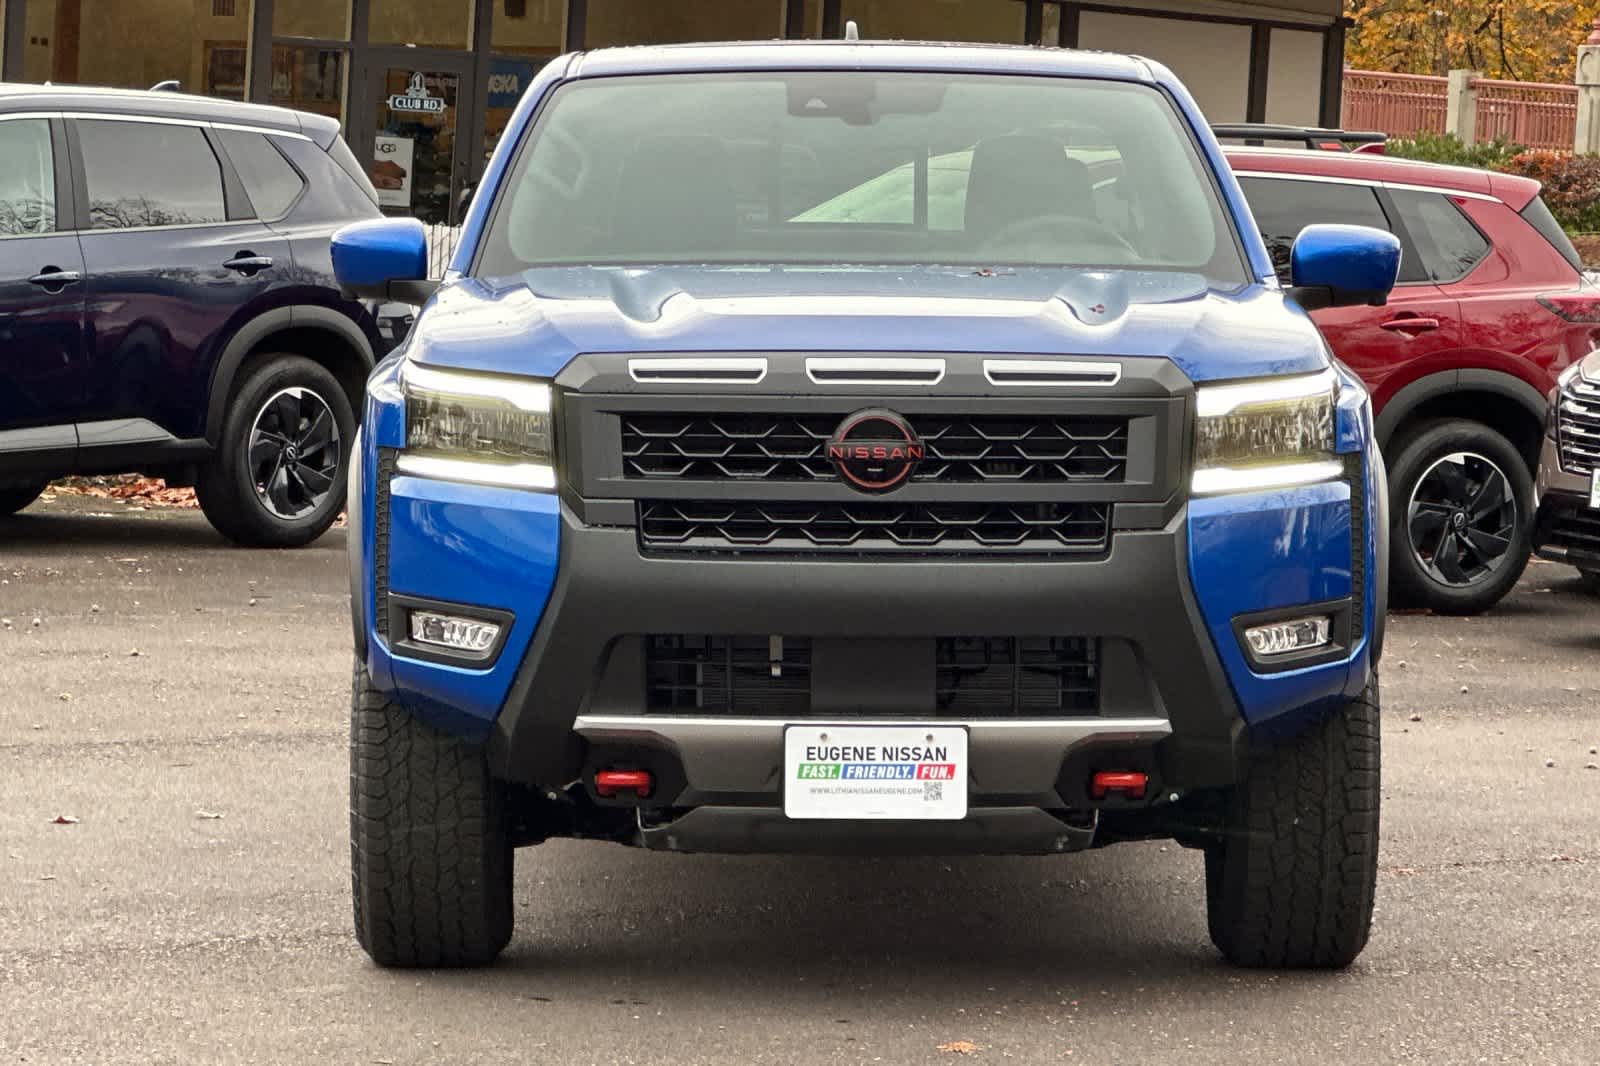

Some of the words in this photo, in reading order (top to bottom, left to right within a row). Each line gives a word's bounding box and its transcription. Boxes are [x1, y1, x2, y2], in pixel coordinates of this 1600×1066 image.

[414, 74, 421, 90] 1
[395, 98, 421, 109] CLUB
[423, 100, 441, 111] RD.
[829, 446, 922, 459] NISSAN
[806, 746, 876, 761] EUGENE
[882, 747, 947, 762] NISSAN
[801, 765, 837, 779] FAST.
[846, 765, 912, 779] FRIENDLY.
[921, 765, 952, 780] FUN.
